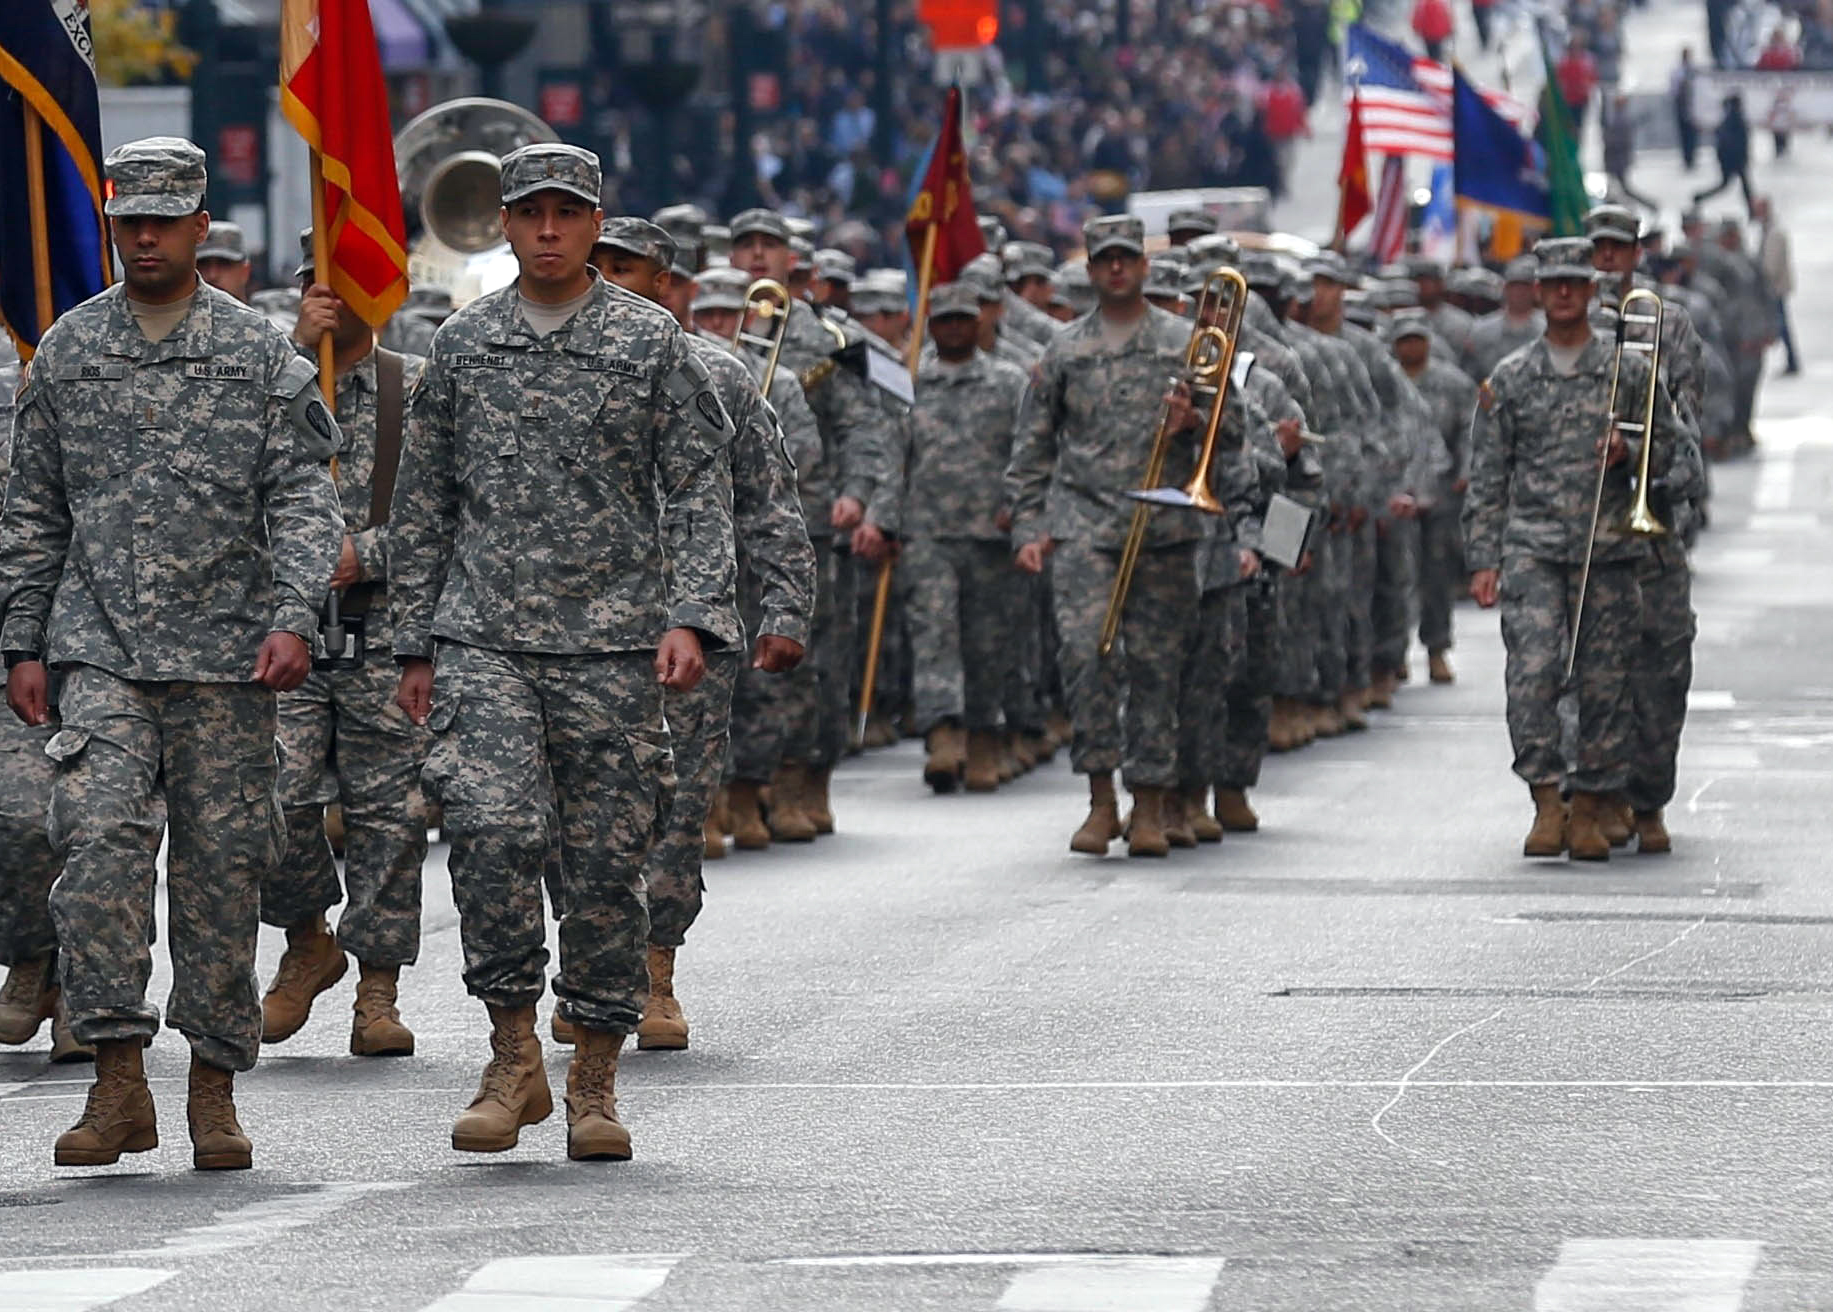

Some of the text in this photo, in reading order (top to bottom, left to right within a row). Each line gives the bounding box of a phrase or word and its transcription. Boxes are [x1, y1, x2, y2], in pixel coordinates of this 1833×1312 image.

[456, 355, 505, 366] BEHRENDT
[80, 366, 101, 378] RIOS
[217, 366, 247, 378] ARMY
[608, 361, 639, 374] ARMY
